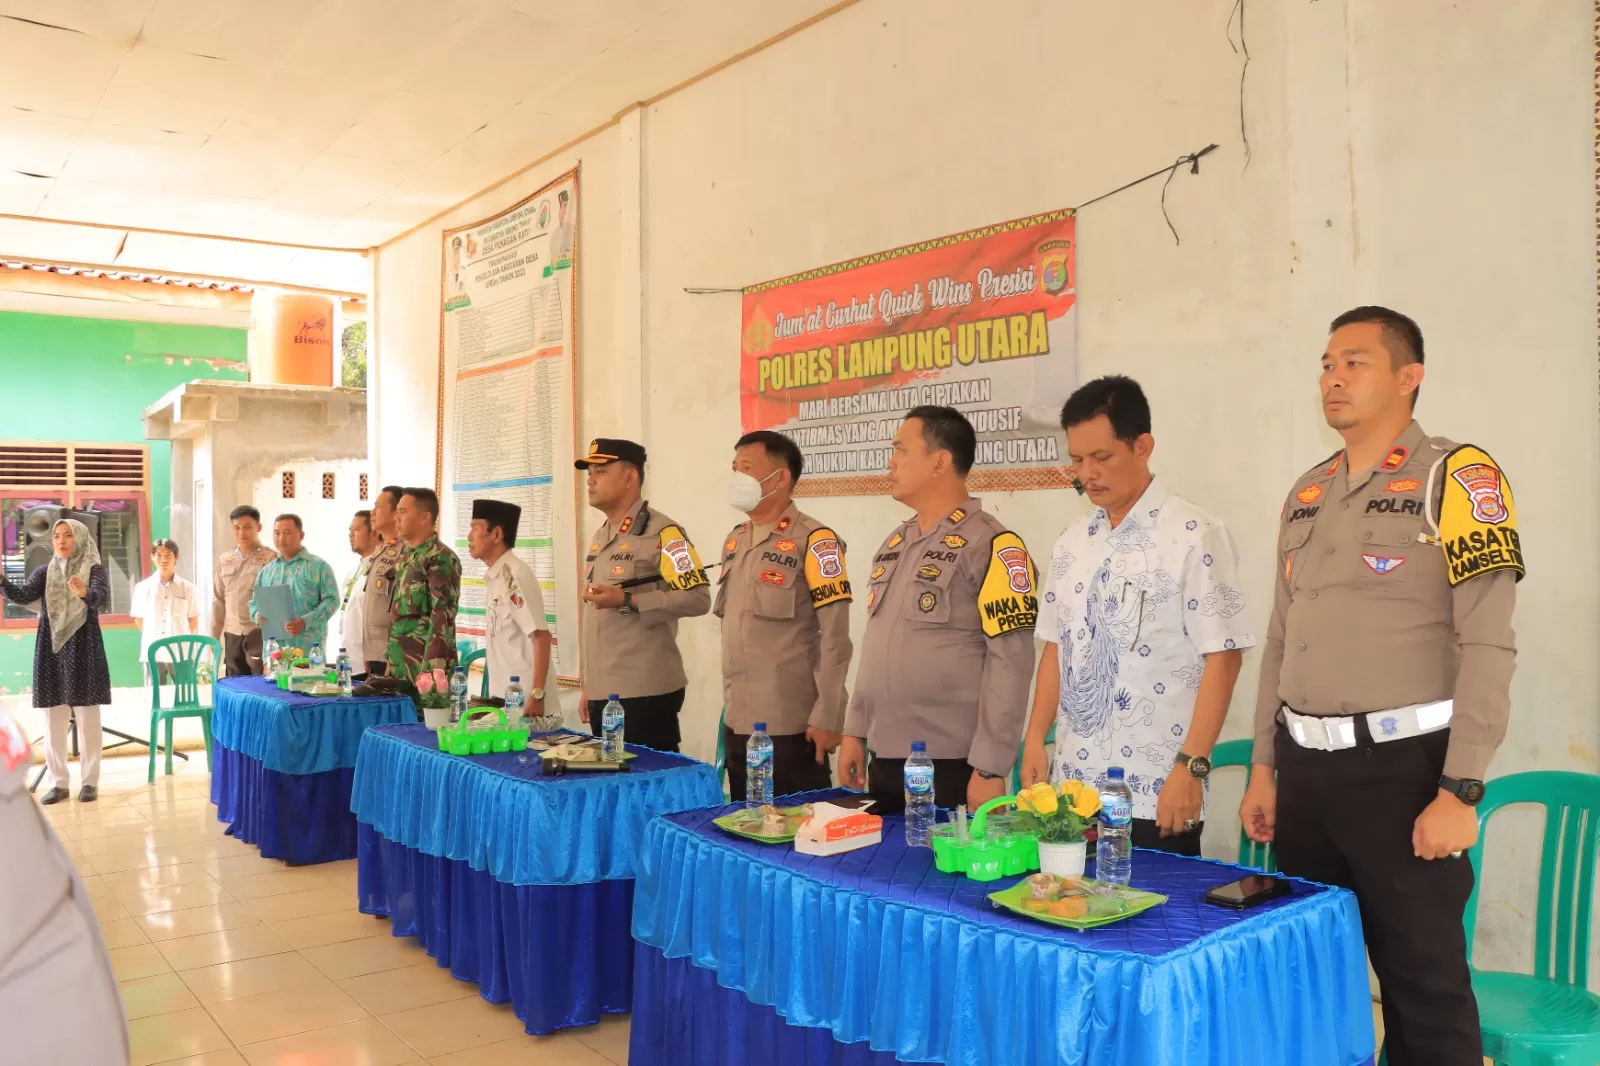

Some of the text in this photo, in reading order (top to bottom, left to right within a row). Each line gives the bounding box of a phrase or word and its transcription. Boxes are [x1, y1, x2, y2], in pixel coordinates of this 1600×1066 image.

[500, 256, 525, 273] ANGGARAN
[525, 252, 539, 264] DESA
[775, 263, 1037, 340] Jum'at Curhat Quick Wins Presisi
[759, 308, 1051, 393] POLRES LAMPUNG UTARA
[799, 377, 992, 422] MARI BERSAMA KITA CIPTAKAN
[844, 420, 877, 444] YANG
[961, 406, 1022, 434] NDUSIF
[814, 449, 858, 474] HUKUM
[974, 439, 1004, 465] UNG
[1006, 435, 1060, 463] UTARA
[1288, 505, 1320, 524] JONI
[1364, 498, 1425, 516] POLRI
[609, 552, 635, 561] POLRI
[761, 551, 798, 569] POLRI
[922, 550, 959, 564] POLRI
[678, 569, 700, 589] OPS
[983, 595, 1022, 621] WAKA
[909, 775, 929, 786] AQUA
[1110, 806, 1132, 818] AQUA
